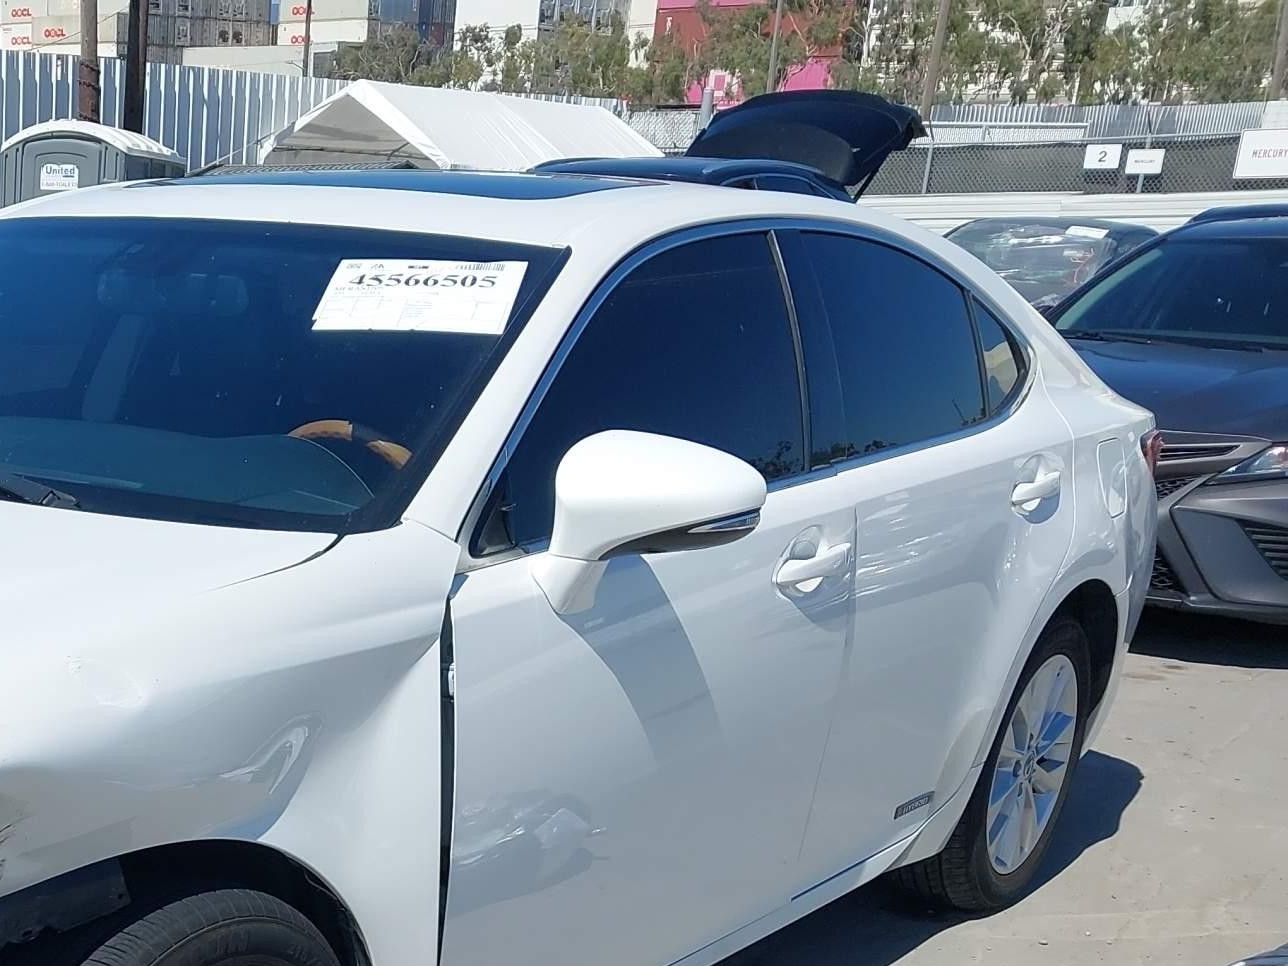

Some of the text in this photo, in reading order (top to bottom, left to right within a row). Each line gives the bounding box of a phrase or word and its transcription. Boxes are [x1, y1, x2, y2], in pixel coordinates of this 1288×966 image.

[11, 8, 32, 17] OOCL
[44, 28, 66, 38] OOCL
[11, 36, 32, 45] OOCL
[1098, 150, 1107, 162] 2
[45, 165, 76, 175] United
[348, 273, 498, 289] 45566505
